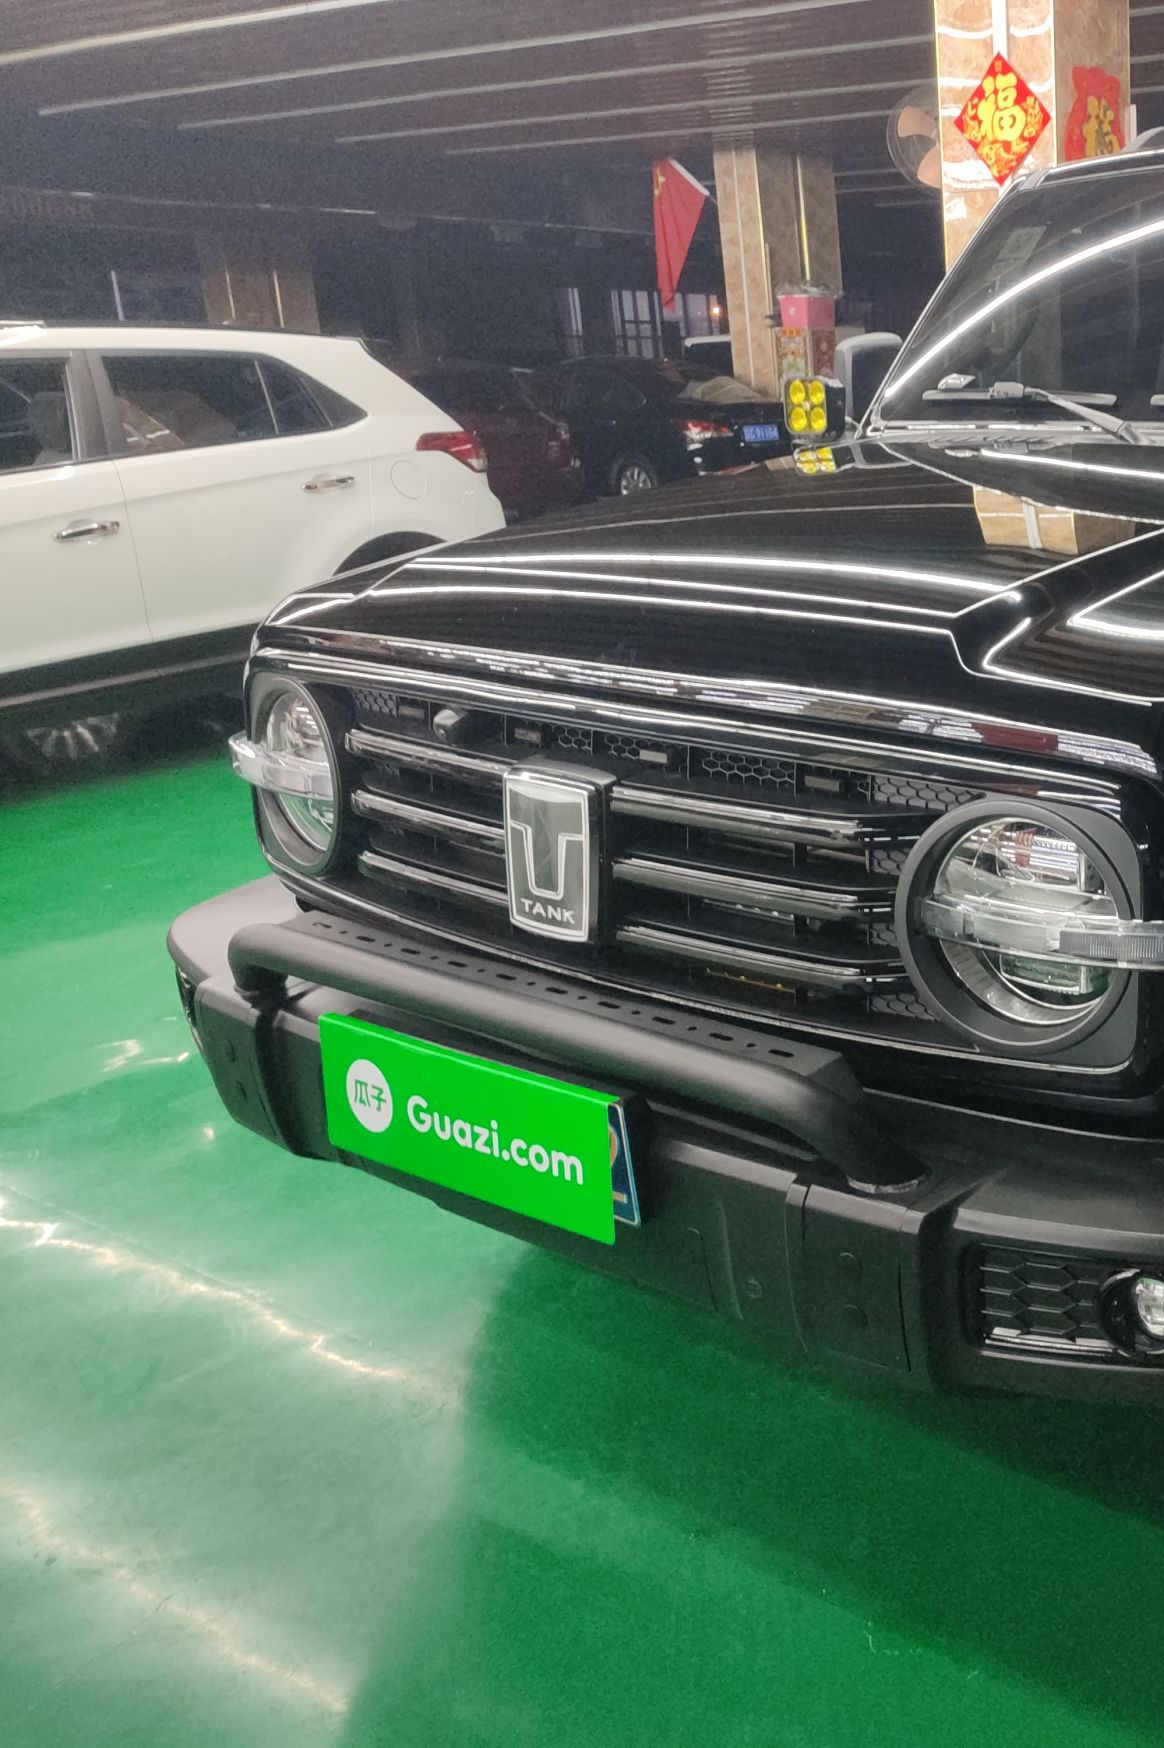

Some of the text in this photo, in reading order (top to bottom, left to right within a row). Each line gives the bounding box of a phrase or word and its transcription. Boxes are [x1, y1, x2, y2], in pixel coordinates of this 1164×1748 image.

[976, 71, 1027, 142] 福
[520, 898, 576, 925] TANK
[354, 1078, 388, 1113] 瓜子
[406, 1094, 584, 1186] Guazi.com
